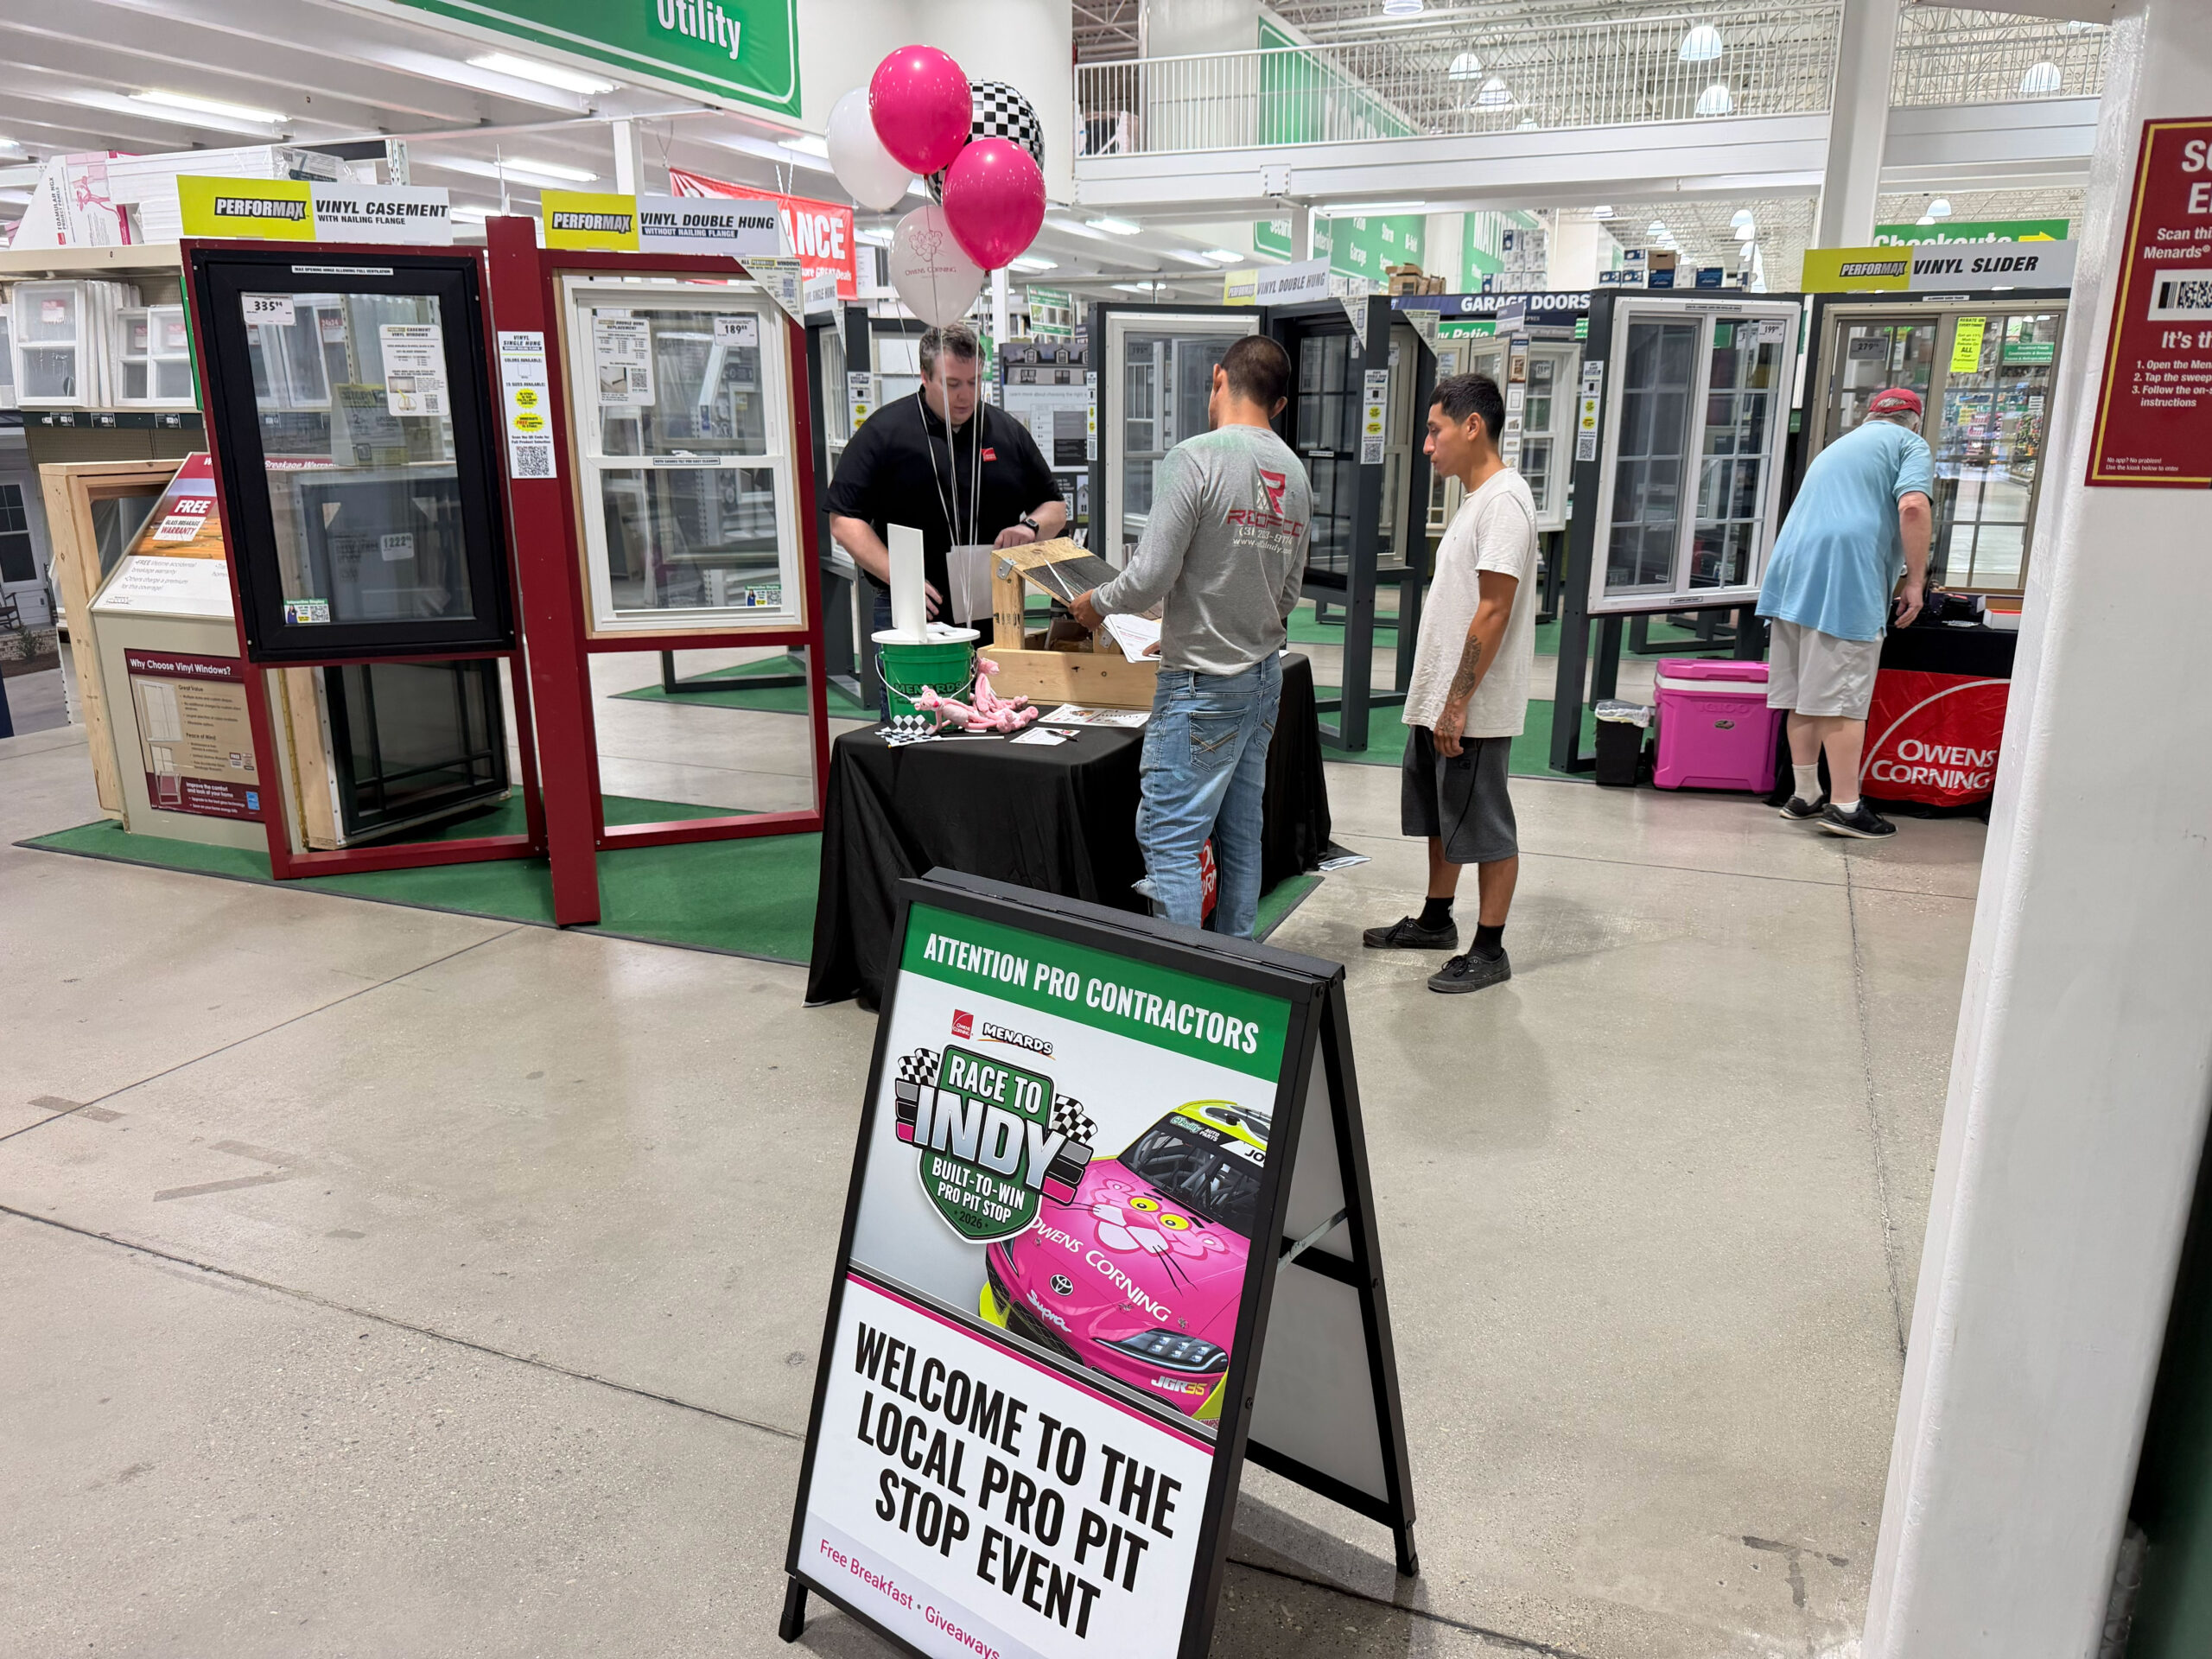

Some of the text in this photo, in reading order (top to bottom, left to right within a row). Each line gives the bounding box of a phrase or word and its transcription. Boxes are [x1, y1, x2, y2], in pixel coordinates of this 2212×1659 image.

[657, 0, 741, 60] Utility
[2188, 182, 2212, 213] E
[215, 197, 448, 220] PERFORMAX VINYL CASEMENT
[341, 215, 372, 224] NAILING
[553, 212, 774, 233] PERFORMAX VINYL DOUBLE HUNG
[645, 227, 735, 238] WITHOUT NAILING FLANGE
[2157, 228, 2190, 240] Scan
[905, 268, 925, 276] OWENS
[1840, 257, 2038, 278] PERFORMAX VINYL SLIDER
[1257, 282, 1276, 296] VINYL
[1279, 276, 1306, 292] DOUBLE
[1306, 272, 1325, 288] HUNG
[1530, 294, 1591, 310] DOORS
[2162, 331, 2192, 348] It's
[2137, 360, 2145, 369] 1.
[2146, 359, 2171, 370] Open
[2173, 359, 2189, 369] the
[2133, 373, 2143, 382] 2.
[2145, 373, 2161, 383] Tap
[2164, 373, 2179, 382] the
[2132, 385, 2140, 394] 3.
[2142, 385, 2173, 394] Follow
[2176, 385, 2190, 394] the
[2140, 397, 2196, 407] instructions
[175, 499, 211, 514] FREE
[161, 526, 196, 536] WARRANTY
[130, 658, 231, 676] Why Choose Vinyl Windows?
[893, 682, 964, 695] MENRDS
[1897, 739, 1998, 768] OWENS
[1871, 760, 1990, 790] CORNING
[924, 933, 1260, 1054] ATTENTION PRO CONTRACTORS
[953, 1027, 969, 1036] CORNING
[957, 1022, 970, 1032] OWENS
[982, 1022, 1053, 1055] MENARDS
[948, 1054, 1043, 1114] RACE TO
[913, 1084, 1067, 1190] INDY
[1199, 1130, 1218, 1141] PARTS
[1204, 1128, 1220, 1137] AUTO
[1244, 1149, 1266, 1162] JO
[931, 1156, 1026, 1211] BUILT-TO-WIN
[937, 1181, 1012, 1224] PRO PIT STOP
[958, 1211, 982, 1229] 2026
[1030, 1216, 1172, 1322] OWENS CORNING
[1151, 1376, 1208, 1395] JGR35
[855, 1320, 1182, 1539] WELCOME TO THE
[857, 1389, 1149, 1593] LOCAL PRO PIT
[875, 1468, 1102, 1640] STOP EVENT
[820, 1538, 1001, 1659] Free Breakfast Giveaways
